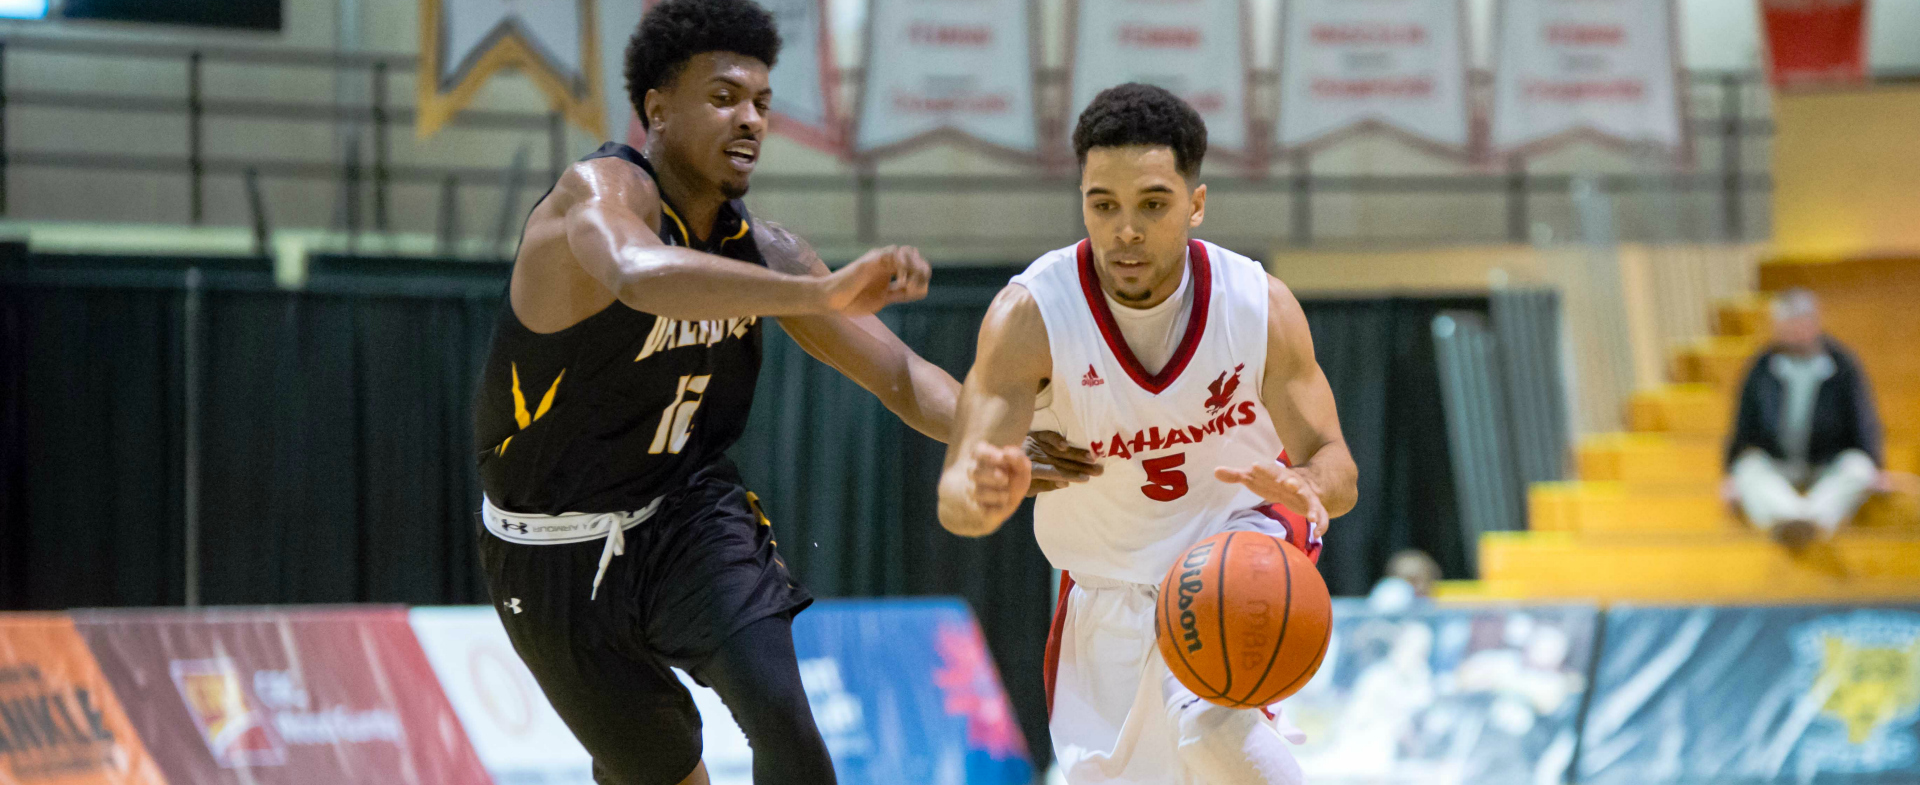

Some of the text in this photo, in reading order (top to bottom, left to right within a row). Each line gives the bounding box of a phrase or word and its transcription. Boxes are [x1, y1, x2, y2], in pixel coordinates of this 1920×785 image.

[1090, 400, 1257, 460] EAHAWKS
[1140, 451, 1189, 502] 5
[1178, 541, 1216, 654] Wilson
